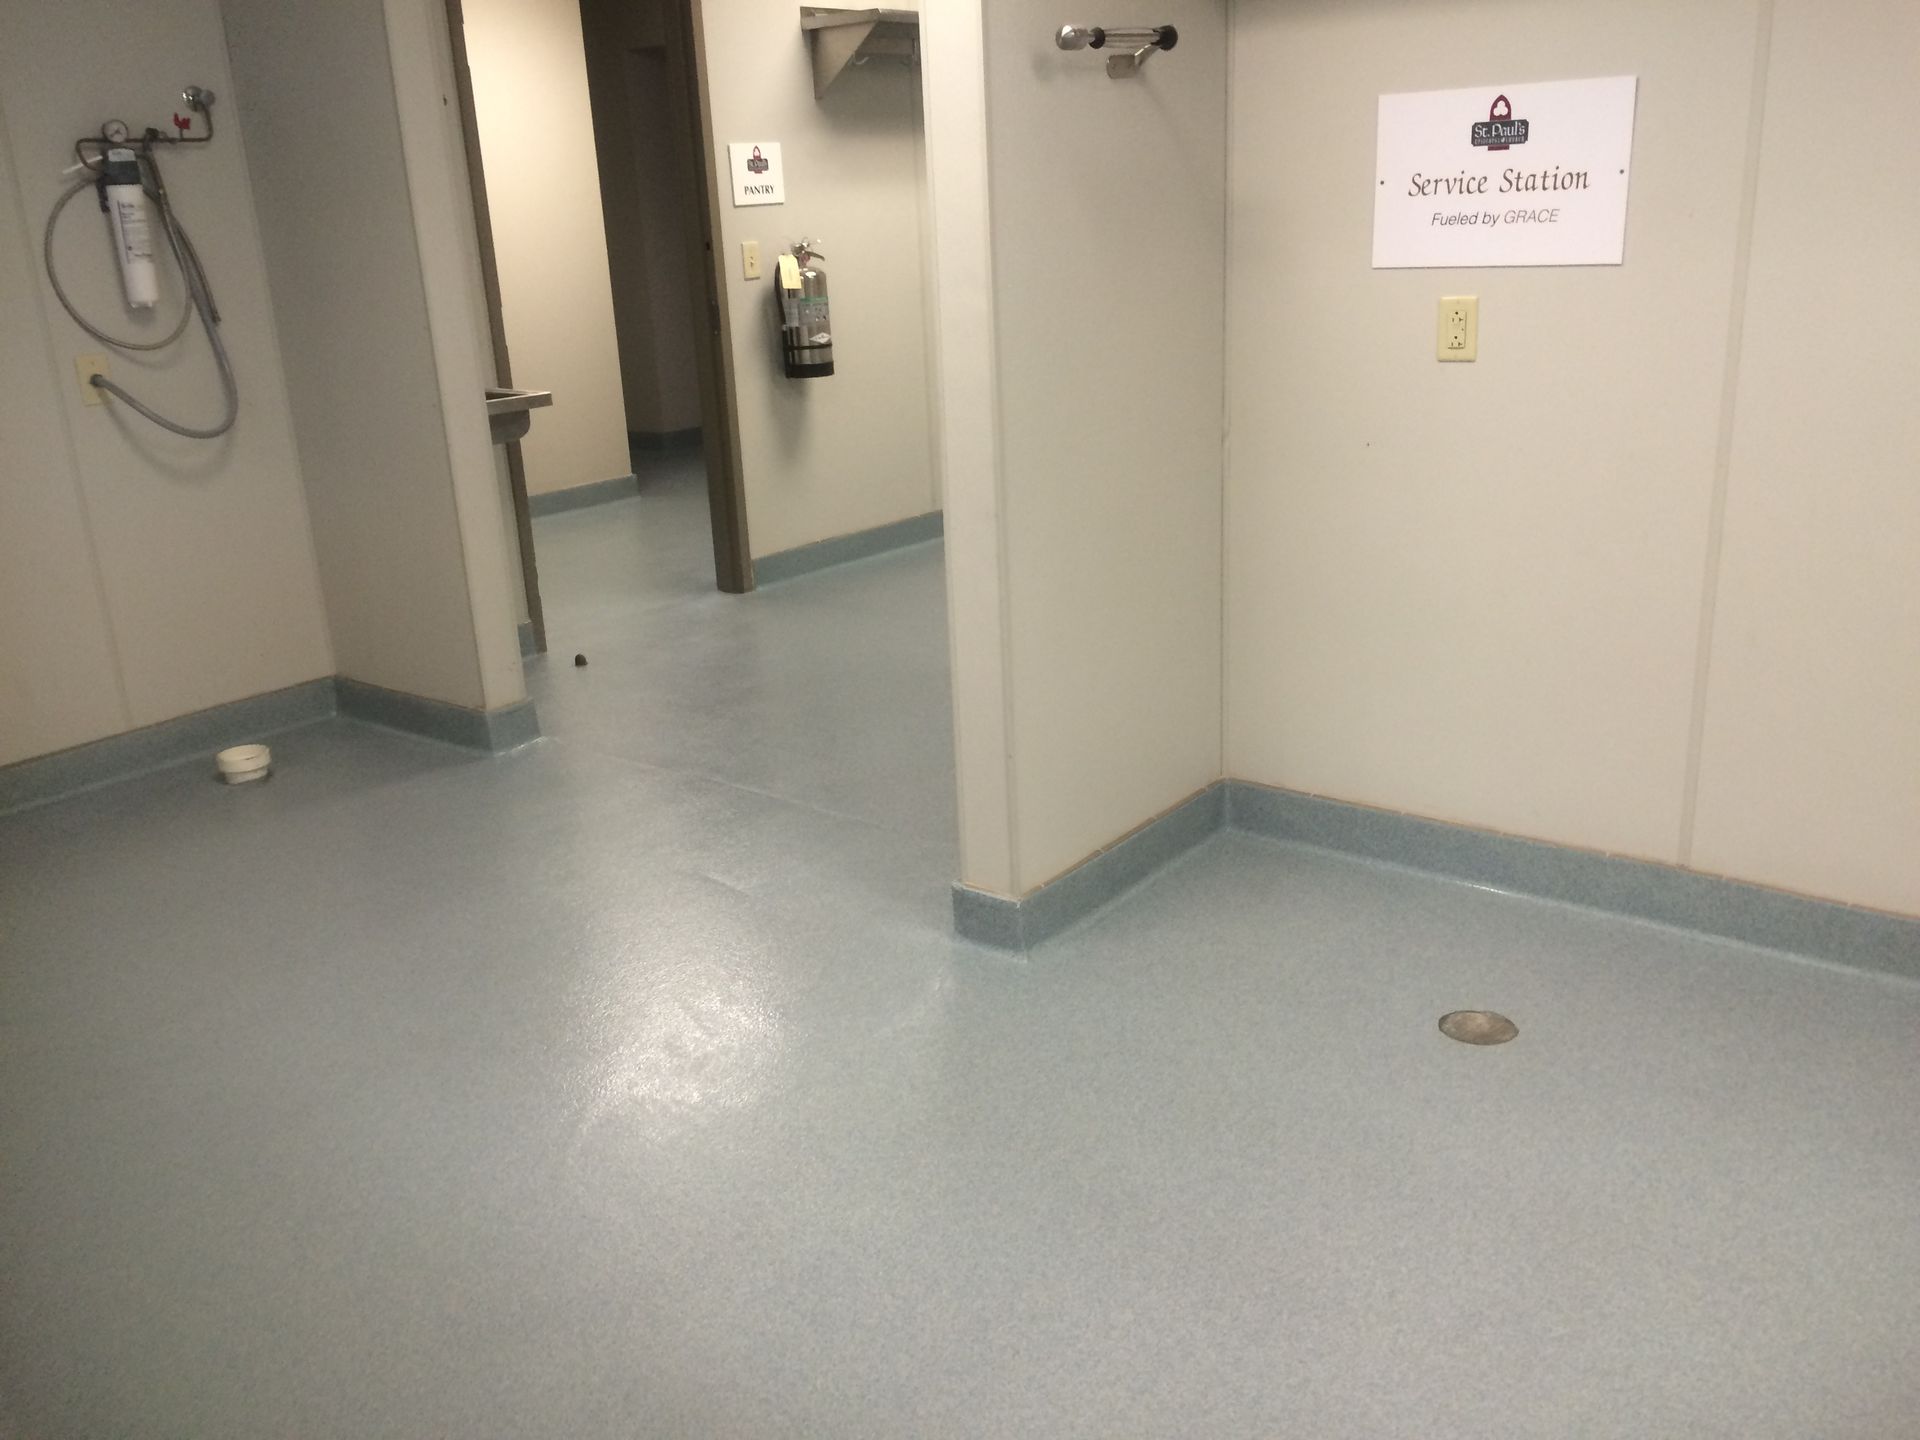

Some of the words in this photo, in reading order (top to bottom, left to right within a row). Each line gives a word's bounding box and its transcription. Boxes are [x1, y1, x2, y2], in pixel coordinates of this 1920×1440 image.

[1474, 124, 1490, 138] St.
[1492, 120, 1526, 137] Paul's
[744, 184, 774, 195] PANTRY
[1408, 170, 1488, 197] Service
[1499, 165, 1590, 193] Station
[1431, 211, 1479, 226] Fueled
[1482, 211, 1500, 227] by
[1504, 208, 1560, 224] GRACE
